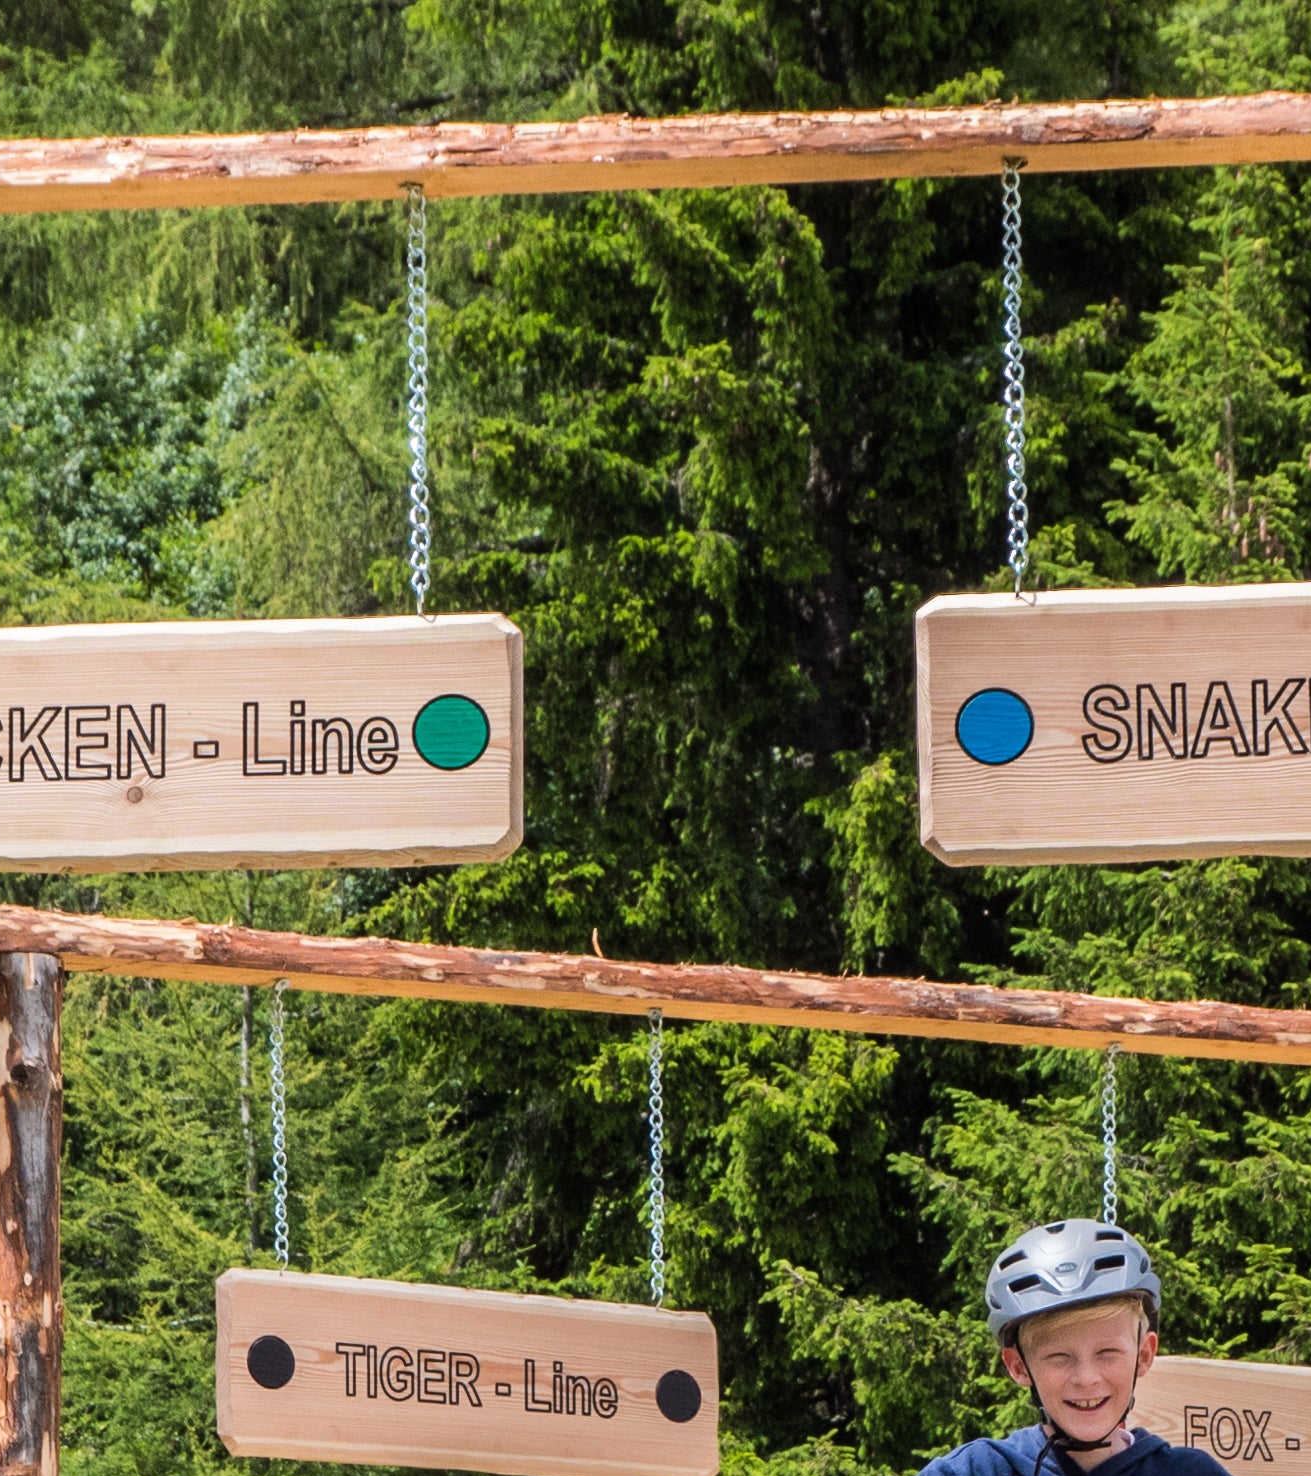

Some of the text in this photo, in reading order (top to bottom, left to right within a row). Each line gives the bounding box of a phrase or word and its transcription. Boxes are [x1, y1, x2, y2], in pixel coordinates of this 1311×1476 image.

[193, 740, 220, 759] -
[242, 700, 400, 777] Line
[335, 1342, 619, 1419] TIGER - Line
[1183, 1405, 1274, 1462] FOX
[1285, 1437, 1301, 1451] -
